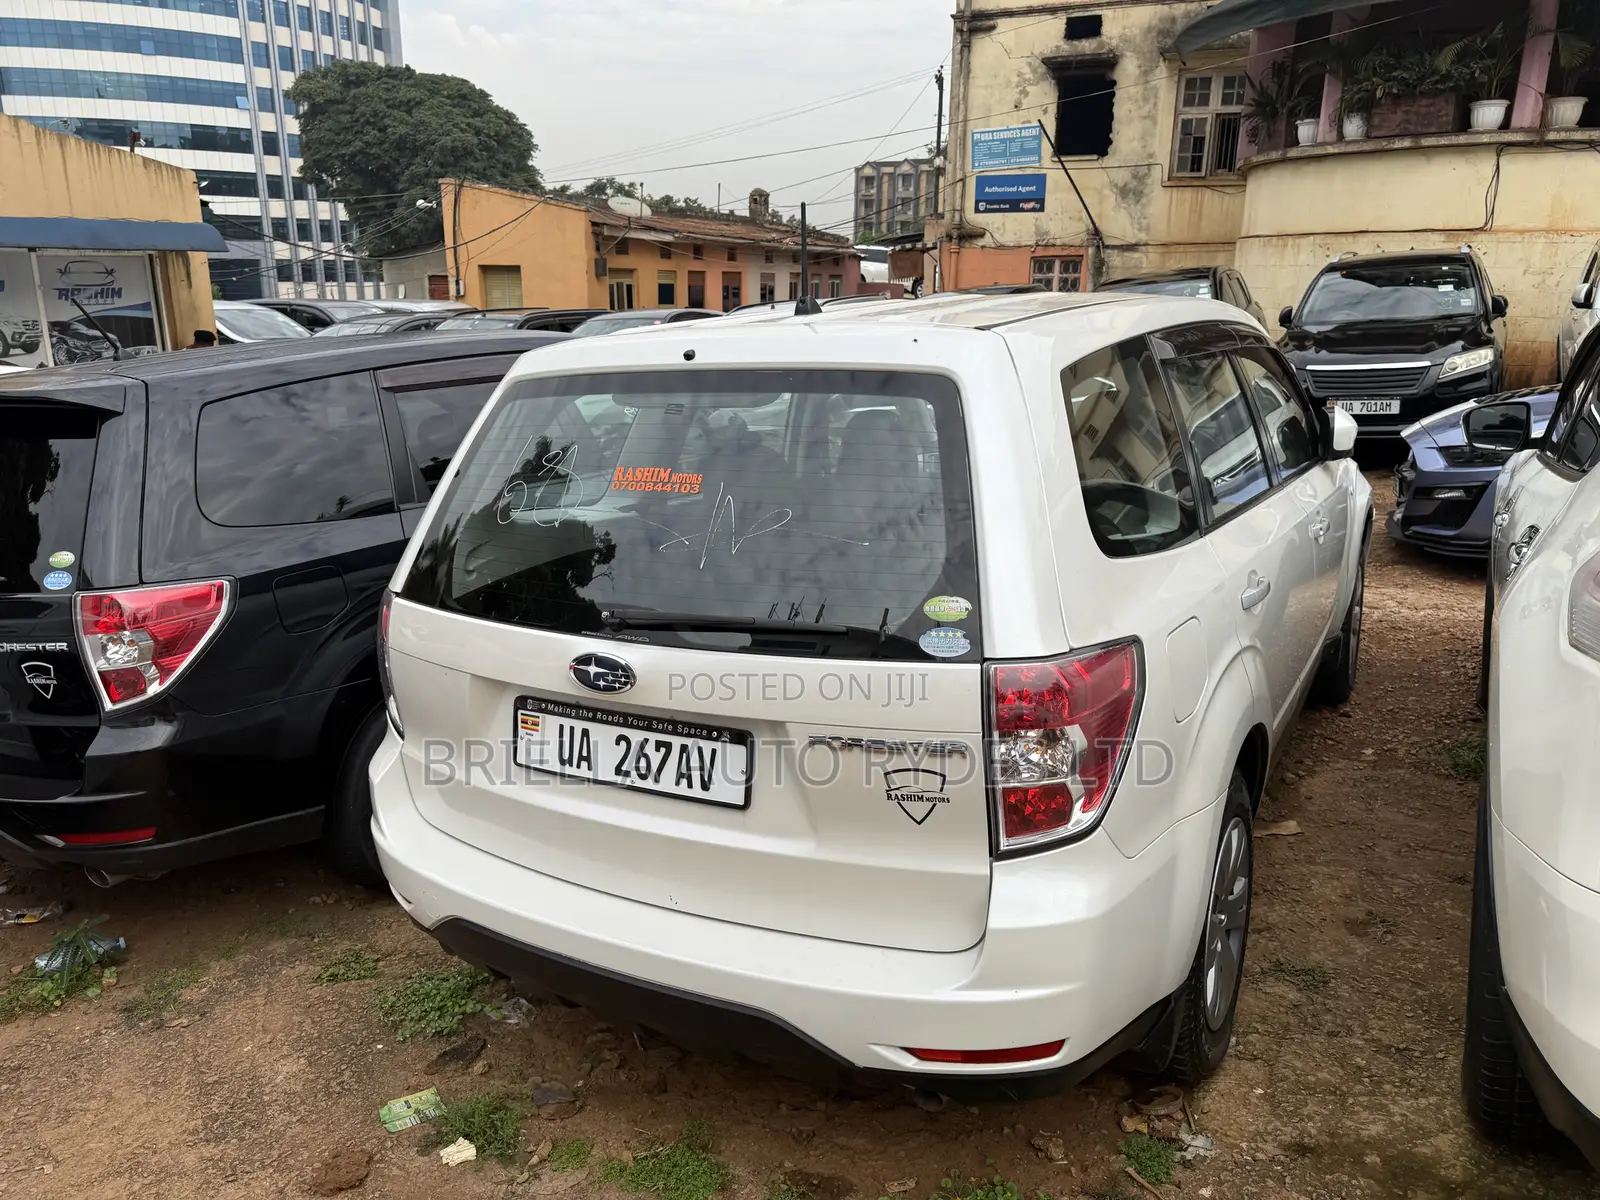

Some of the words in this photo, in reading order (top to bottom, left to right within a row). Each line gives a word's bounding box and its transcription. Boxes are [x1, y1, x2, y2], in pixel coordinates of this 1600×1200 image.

[993, 129, 1021, 139] SERVICES
[1021, 128, 1040, 137] AGENT
[1018, 185, 1036, 193] Agent
[1341, 402, 1354, 412] UA
[1360, 402, 1392, 412] 701AM
[613, 467, 672, 482] RASHIM
[671, 473, 704, 485] MOTORS
[610, 481, 700, 494] 0700844103
[615, 634, 650, 643] AWD
[547, 703, 576, 717] Making
[579, 709, 594, 719] the
[596, 712, 624, 724] Roads
[627, 716, 649, 728] Your
[652, 720, 674, 732] Safe
[677, 725, 708, 737] Space
[558, 723, 593, 772] UA
[614, 733, 717, 792] 267AV
[886, 792, 925, 803] RASHIM
[925, 796, 951, 804] MOTORS
